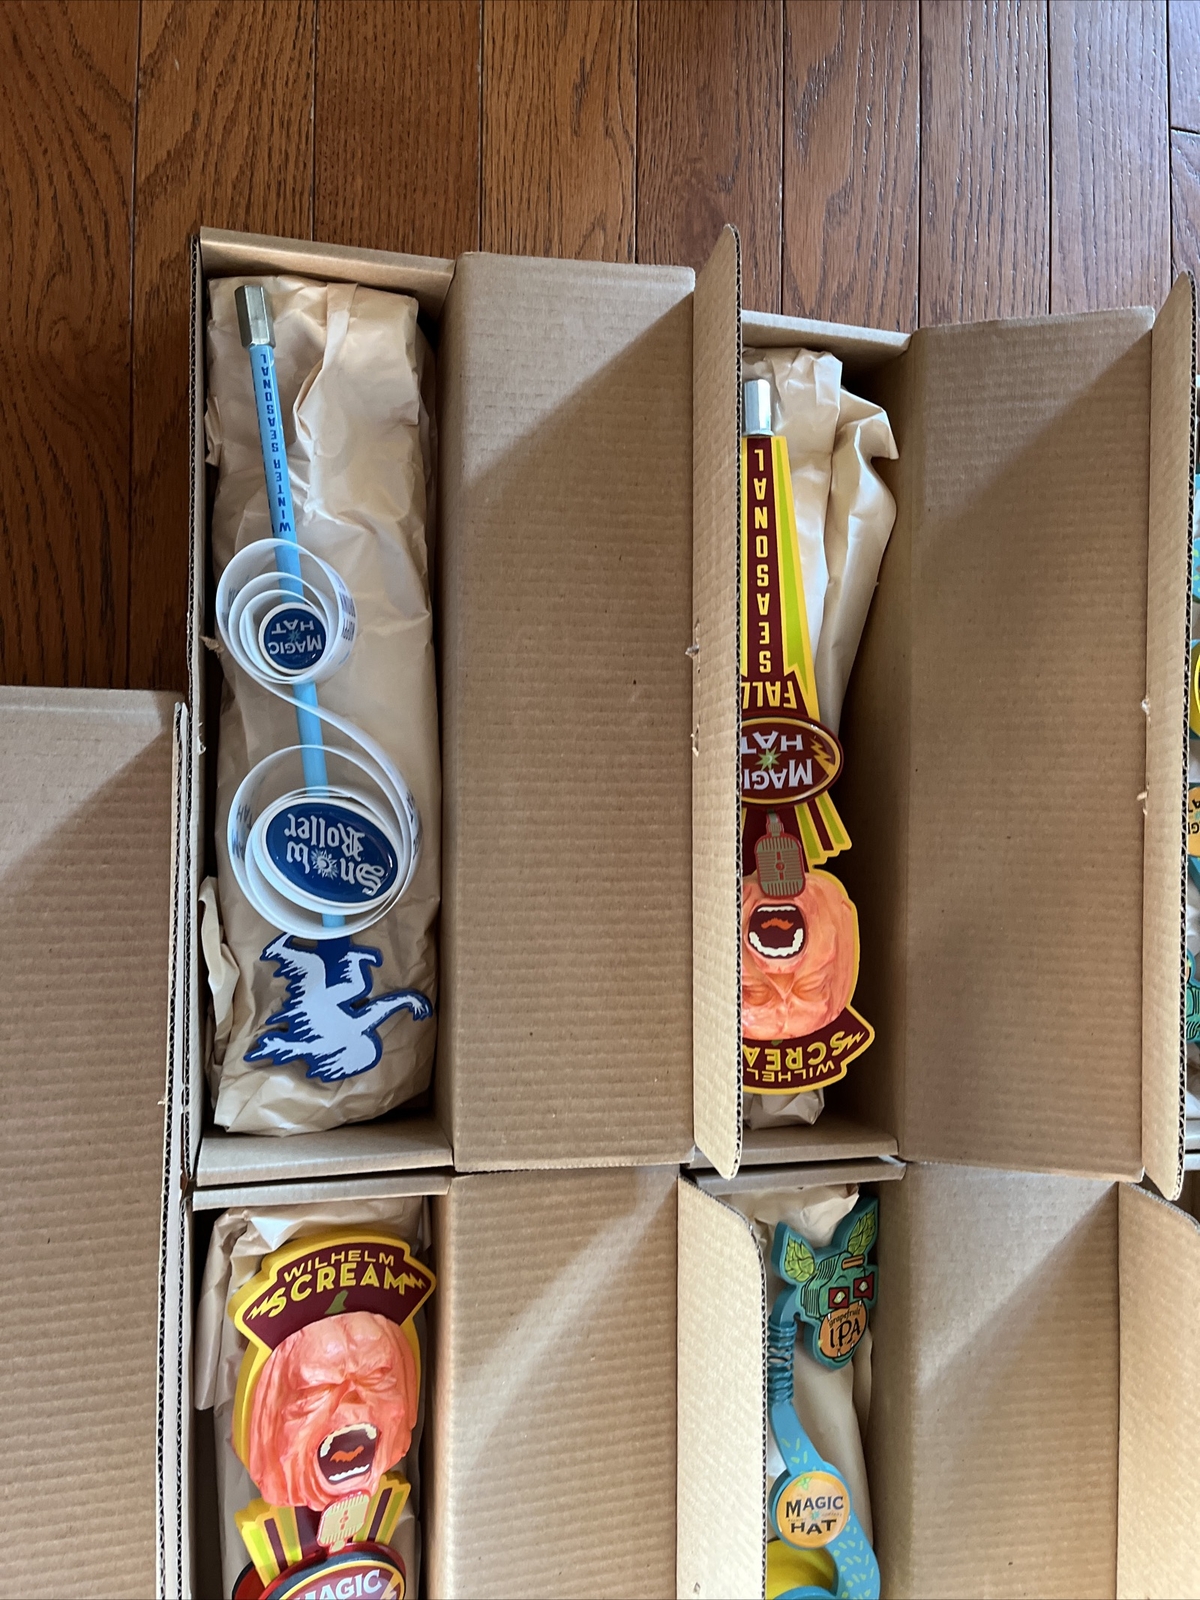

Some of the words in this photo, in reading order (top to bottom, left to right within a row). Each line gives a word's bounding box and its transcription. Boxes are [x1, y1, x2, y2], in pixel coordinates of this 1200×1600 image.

[261, 354, 279, 453] SEASONAL
[273, 459, 291, 533] WINTER
[754, 449, 771, 673] SEASONAL
[272, 619, 315, 635] HAT
[268, 635, 322, 654] MAGIC
[740, 681, 797, 709] FALL
[741, 730, 803, 754] HAT
[743, 759, 813, 790] MAGI
[284, 813, 365, 862] Roller
[742, 1031, 865, 1070] SCREA
[742, 1060, 835, 1082] WILHEL
[283, 1250, 394, 1283] WILHELM
[247, 1262, 426, 1318] SCREAM
[785, 1496, 844, 1518] MAGIC
[791, 1519, 837, 1535] HAT
